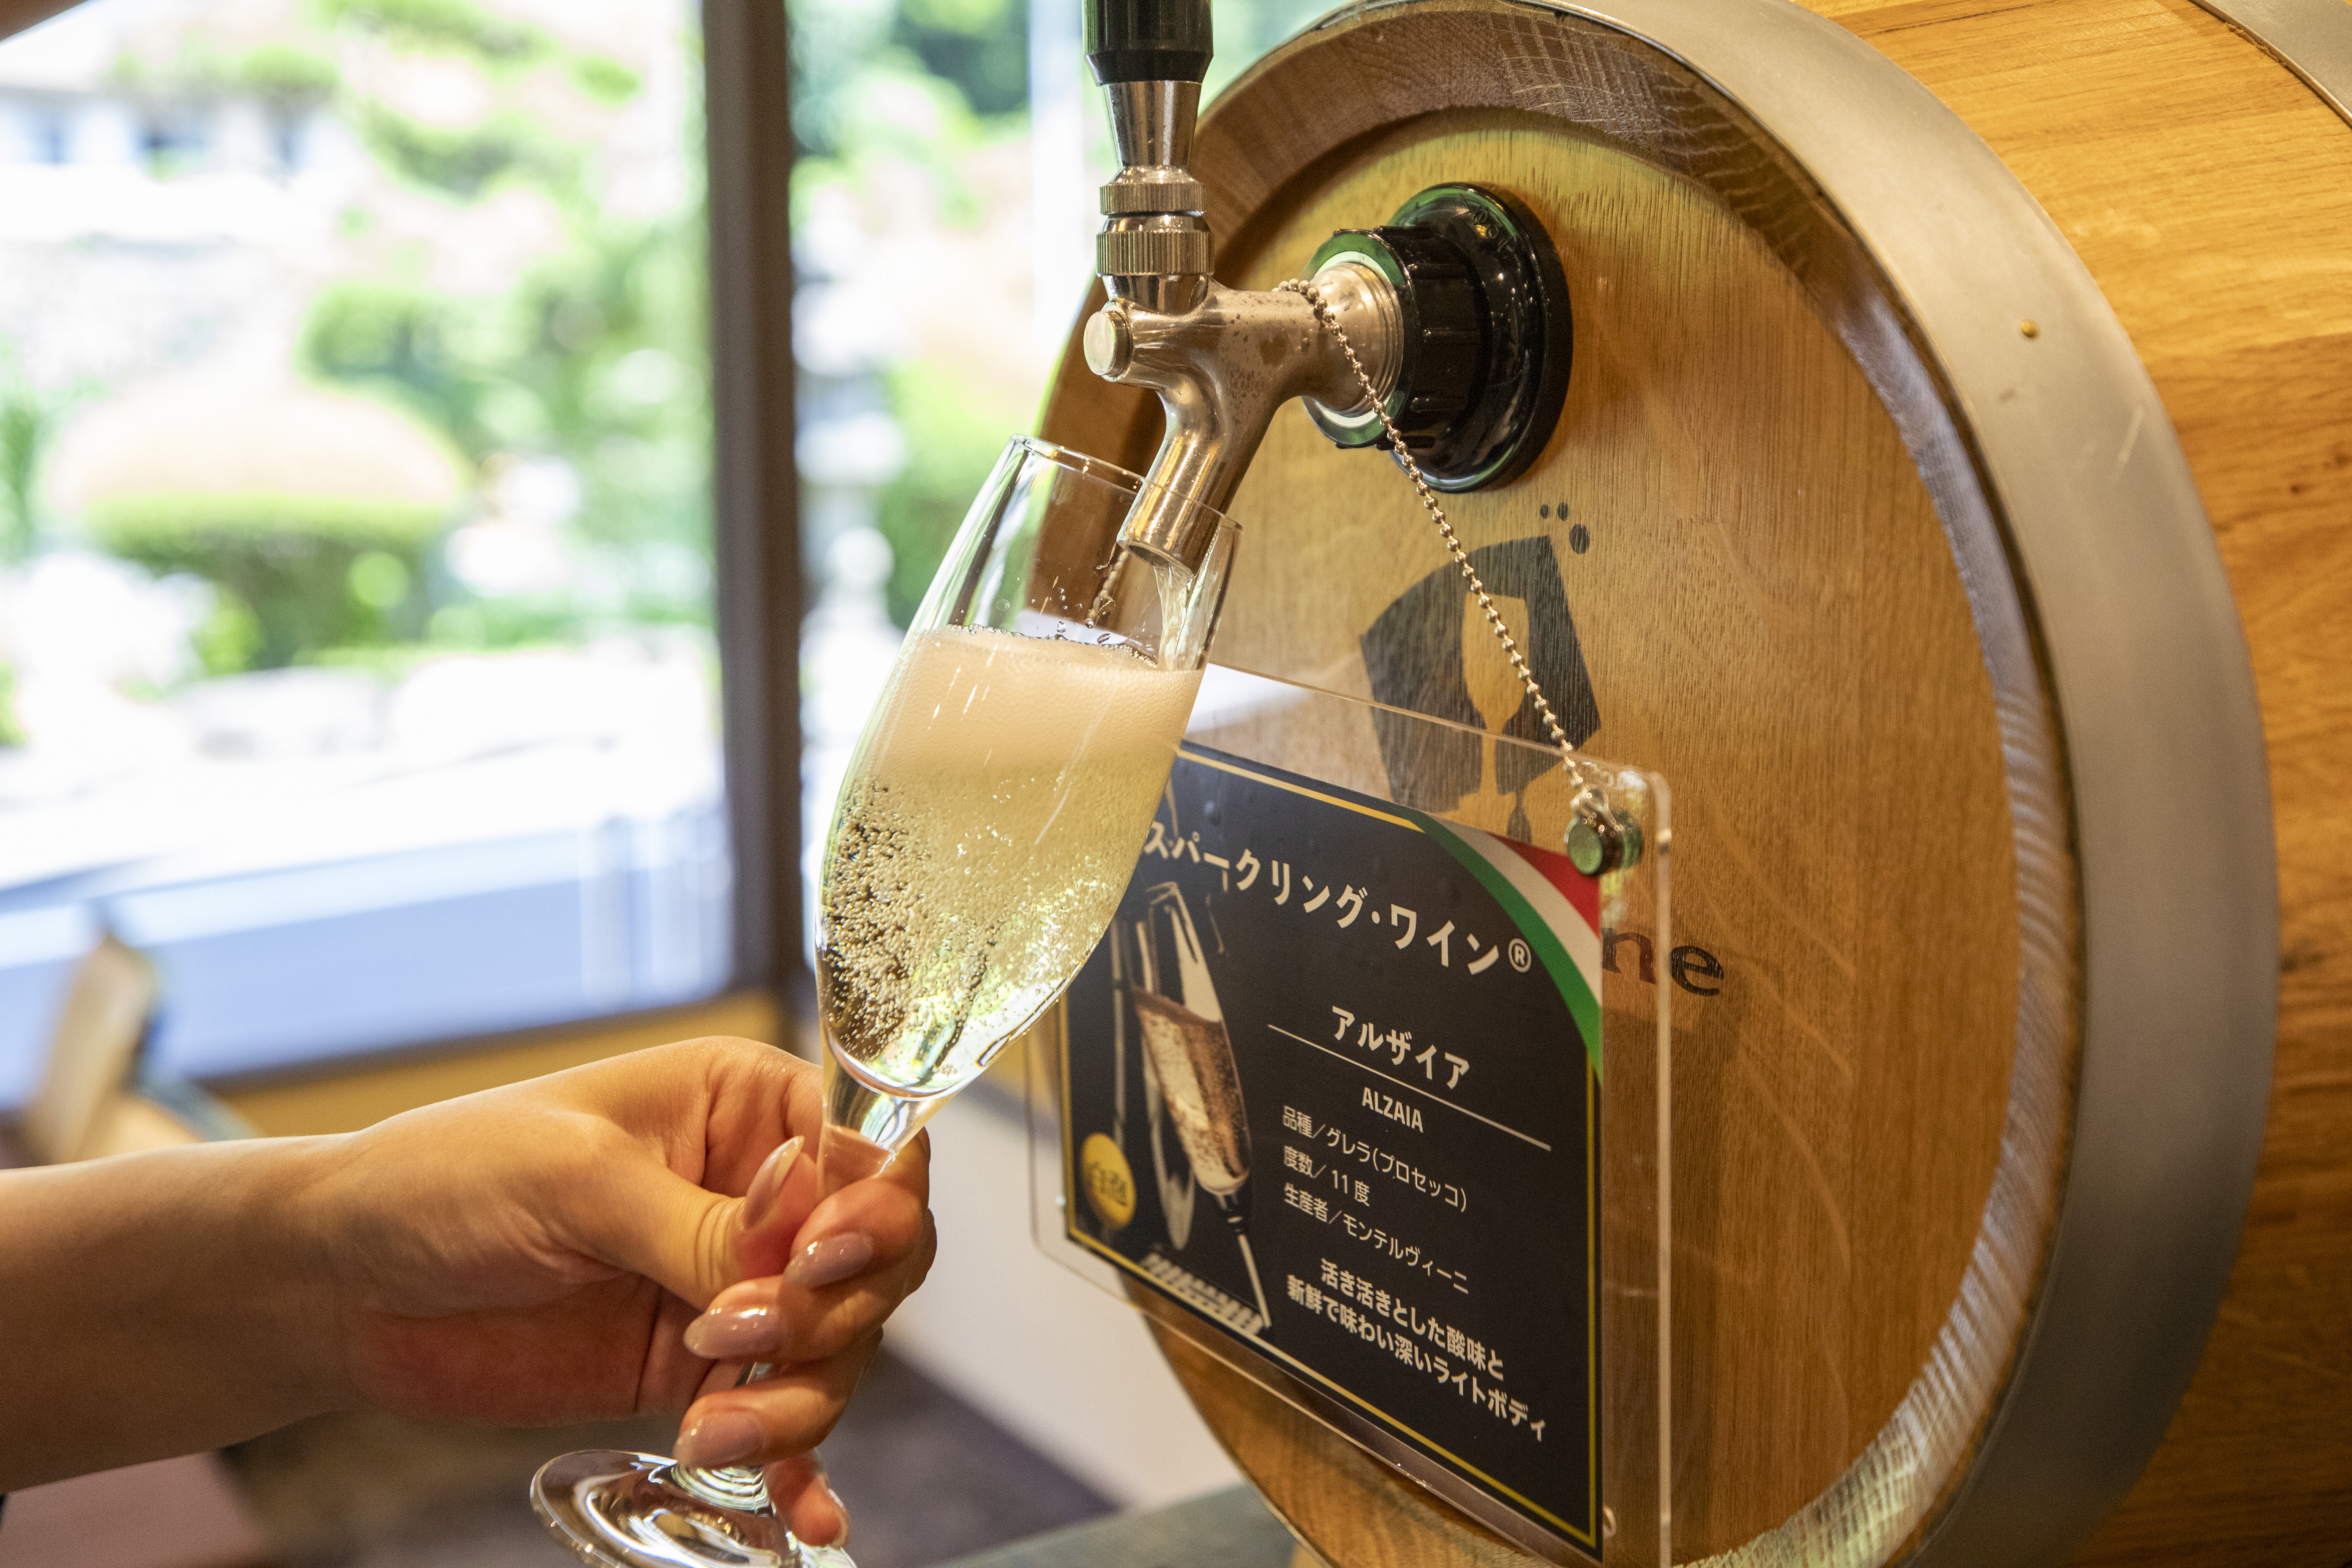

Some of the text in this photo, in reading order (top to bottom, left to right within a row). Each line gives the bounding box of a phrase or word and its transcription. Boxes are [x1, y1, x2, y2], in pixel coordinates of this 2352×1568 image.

[1332, 1005, 1470, 1089] アルザイア
[1362, 1087, 1424, 1133] ALZAIA
[1287, 1274, 1545, 1442] 新鮮で味わい深いライトボディ
[1321, 1258, 1503, 1381] 活き活きとした酸味と
